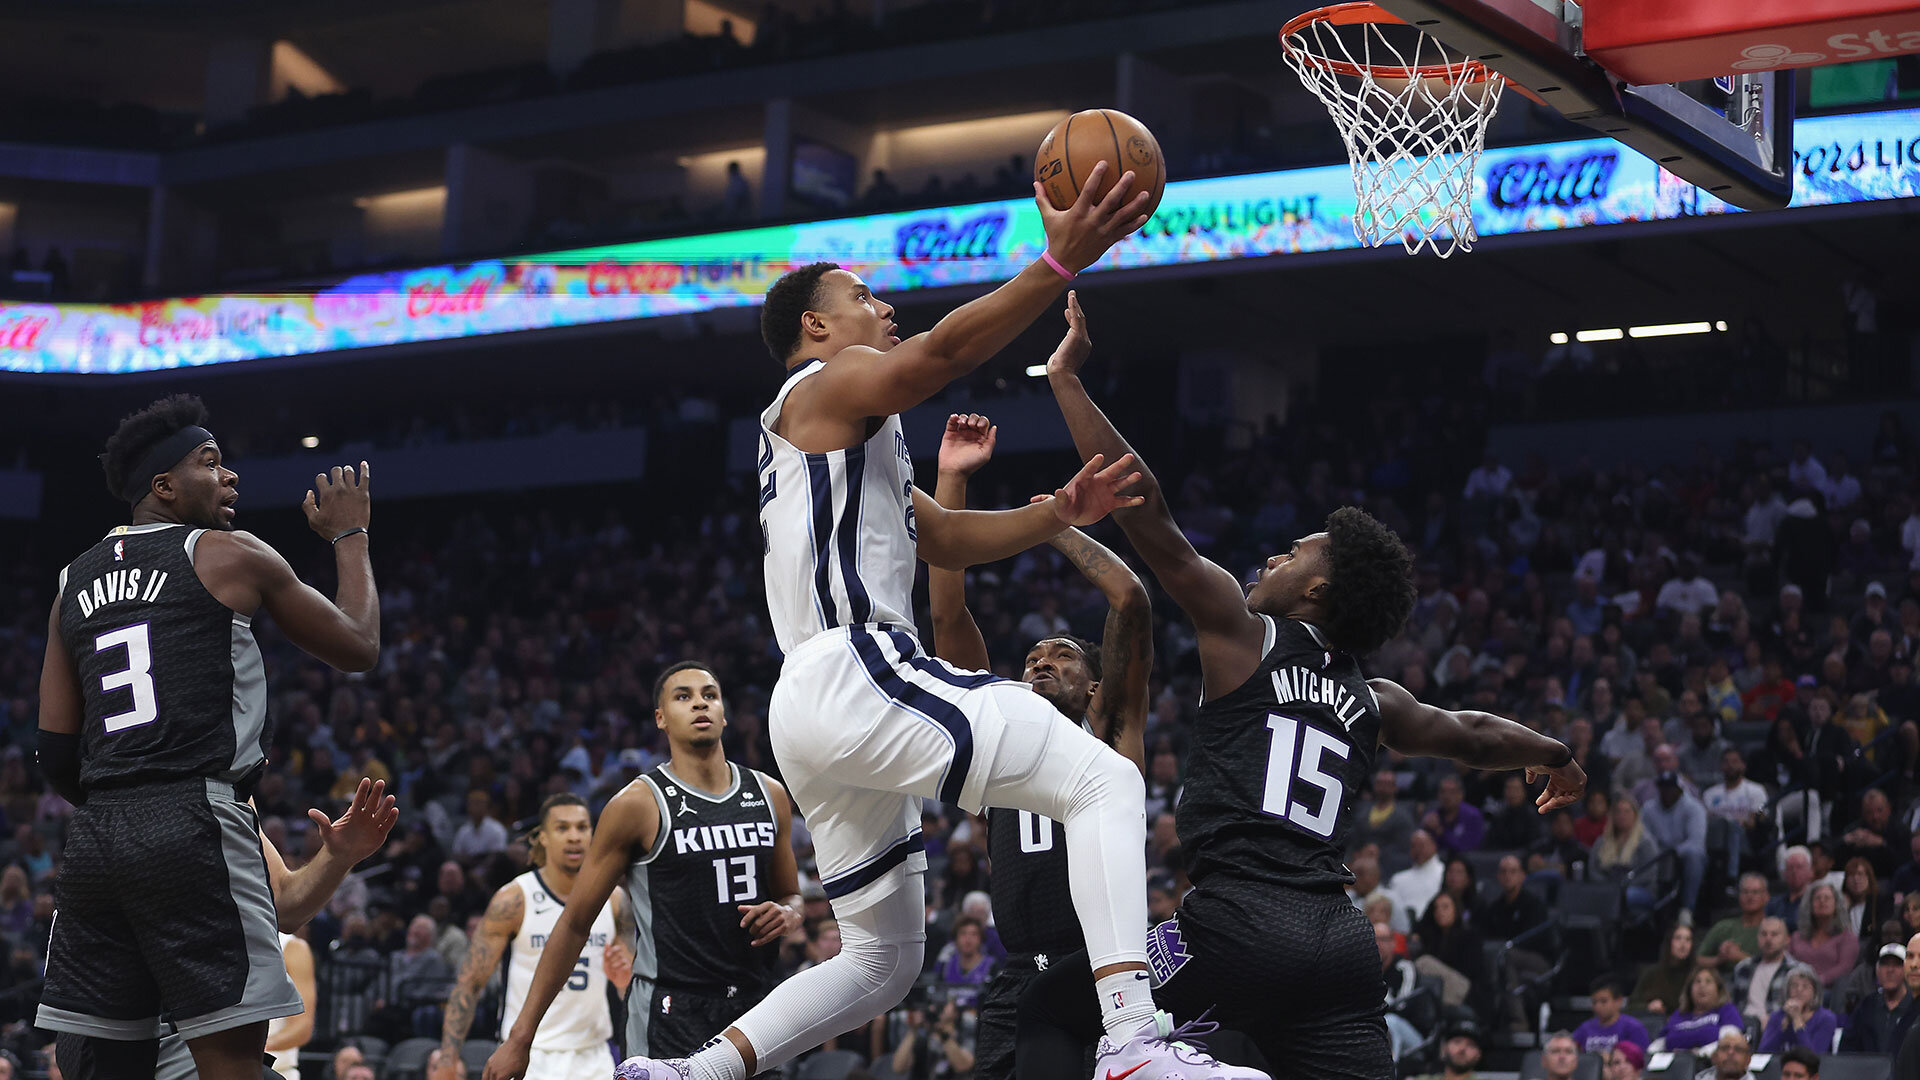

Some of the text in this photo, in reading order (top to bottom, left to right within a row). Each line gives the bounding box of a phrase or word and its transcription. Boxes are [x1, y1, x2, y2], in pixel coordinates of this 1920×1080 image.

[1491, 151, 1618, 209] Chill
[1226, 195, 1319, 230] LIGHT
[77, 568, 169, 619] DAVIS II
[94, 620, 160, 736] 3
[1271, 665, 1367, 733] MITCHELL
[664, 785, 678, 797] 6
[1261, 711, 1351, 838] 15
[673, 822, 775, 855] KINGS
[712, 855, 758, 904] 13
